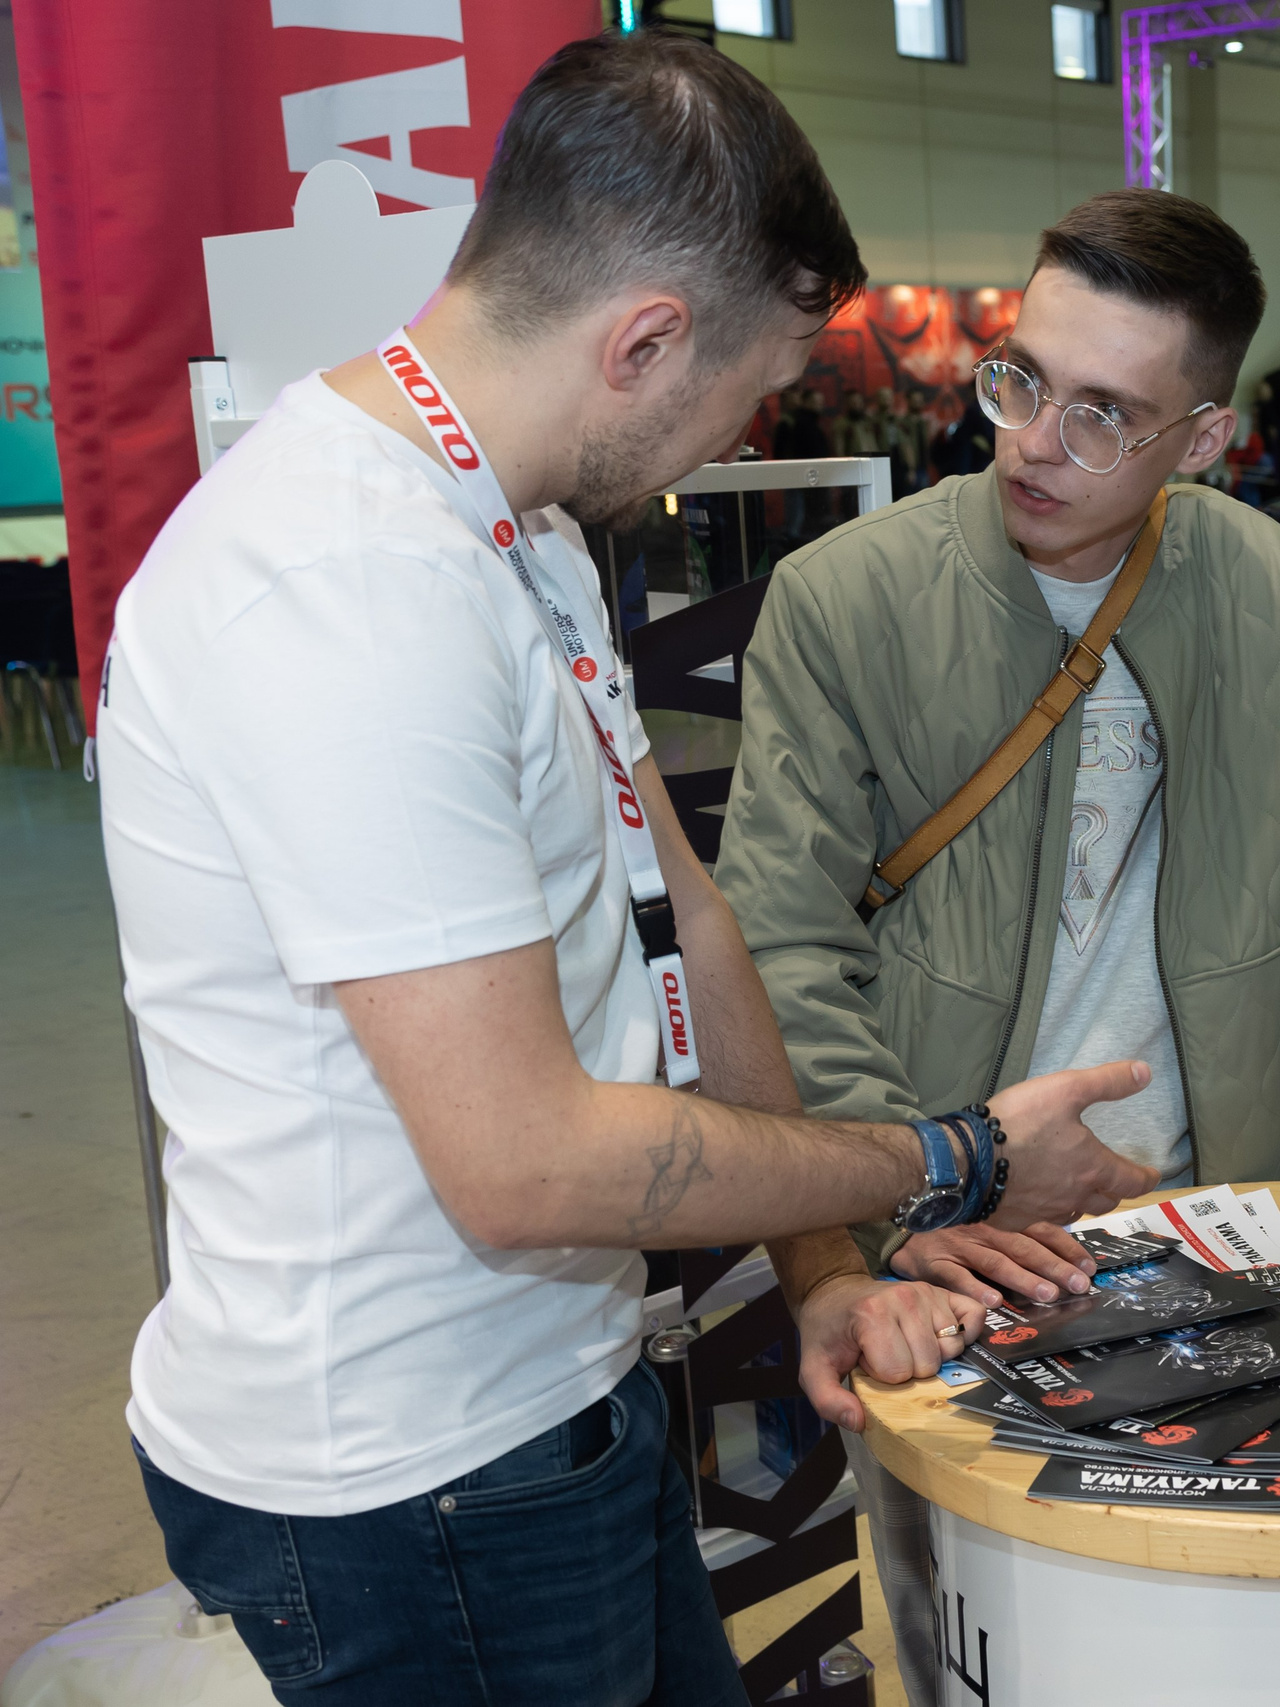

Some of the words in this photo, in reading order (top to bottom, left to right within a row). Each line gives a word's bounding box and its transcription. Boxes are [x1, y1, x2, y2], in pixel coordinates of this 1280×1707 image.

[383, 345, 480, 471] MOTO
[563, 614, 587, 654] MOTORS
[579, 660, 594, 679] UM
[1077, 720, 1162, 772] ESS
[662, 971, 689, 1056] MOTO
[1214, 1222, 1266, 1264] TAKAYAMA
[1014, 1359, 1066, 1391] TAKA
[1081, 1471, 1261, 1491] TAKAYAMA
[1083, 1464, 1134, 1473] КАЧЕСТВО
[1079, 1484, 1128, 1493] МАСЛА
[1128, 1488, 1207, 1497] МОТОРНЫЕ
